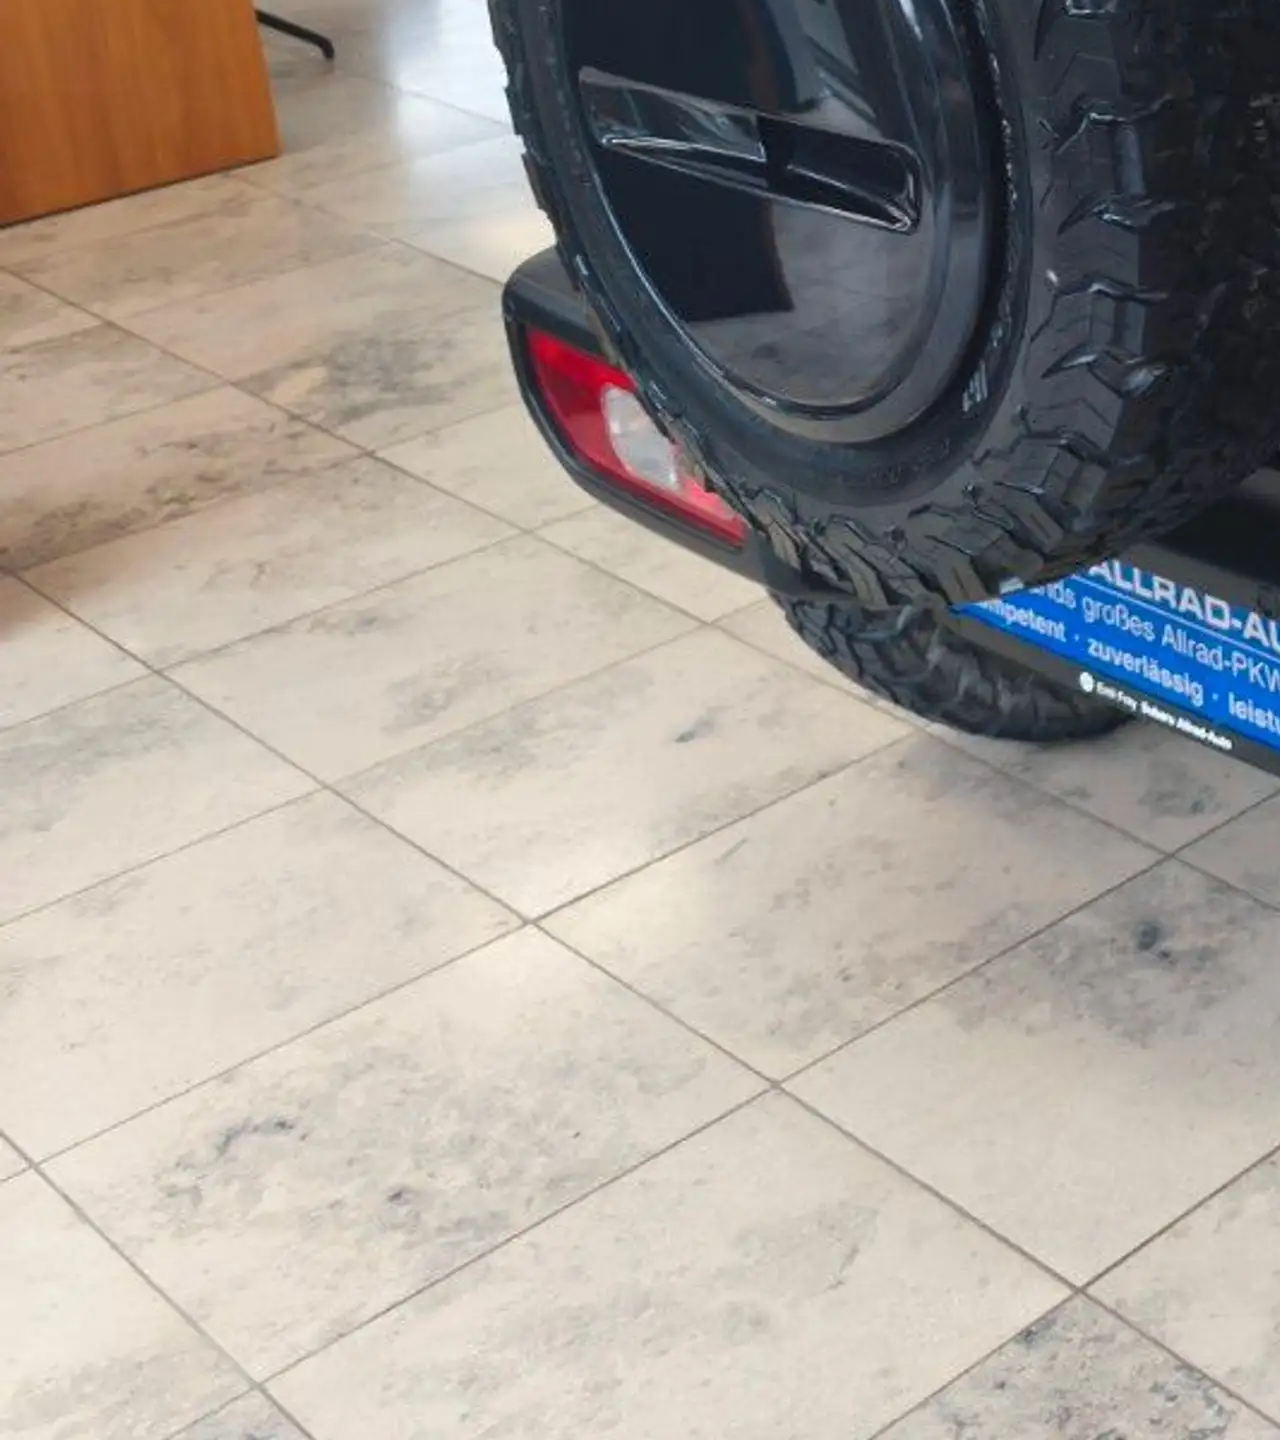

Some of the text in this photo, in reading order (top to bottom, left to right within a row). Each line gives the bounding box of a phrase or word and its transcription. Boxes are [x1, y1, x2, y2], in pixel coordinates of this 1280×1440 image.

[975, 598, 1068, 643] mpetent
[1086, 637, 1205, 708] zuverlässig
[1082, 595, 1157, 642] großes
